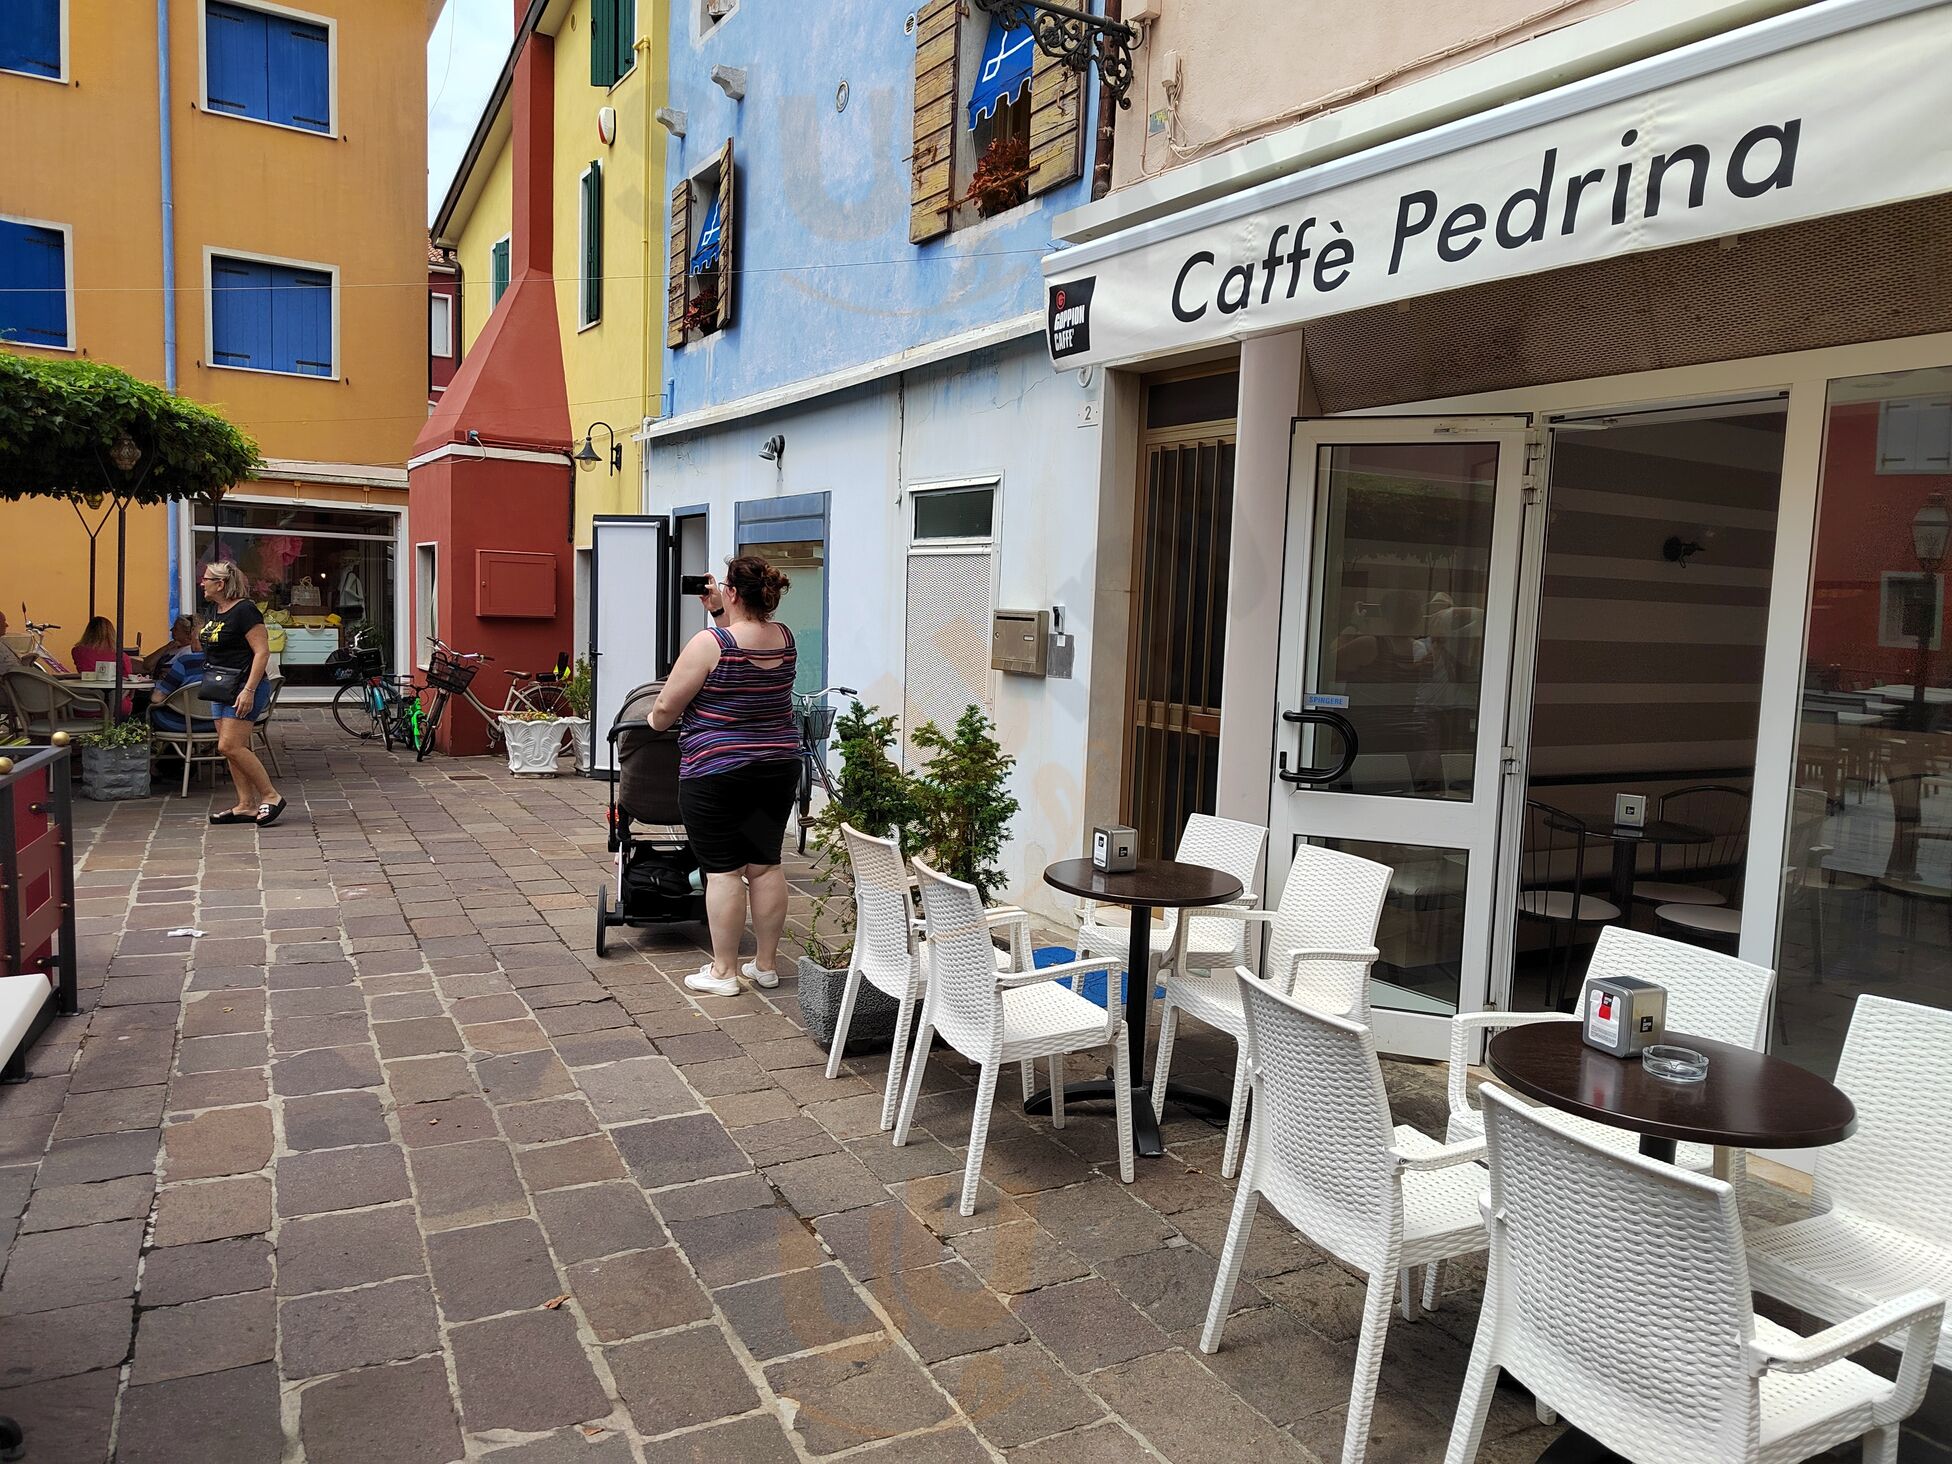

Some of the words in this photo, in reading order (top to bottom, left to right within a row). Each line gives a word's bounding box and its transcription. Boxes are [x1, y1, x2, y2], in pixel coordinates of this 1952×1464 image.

[1171, 217, 1356, 323] Caffè
[1387, 117, 1803, 276] Pedrina
[1054, 305, 1085, 330] GOPPION
[1084, 405, 1092, 421] 2
[1308, 696, 1343, 705] SPINGERE
